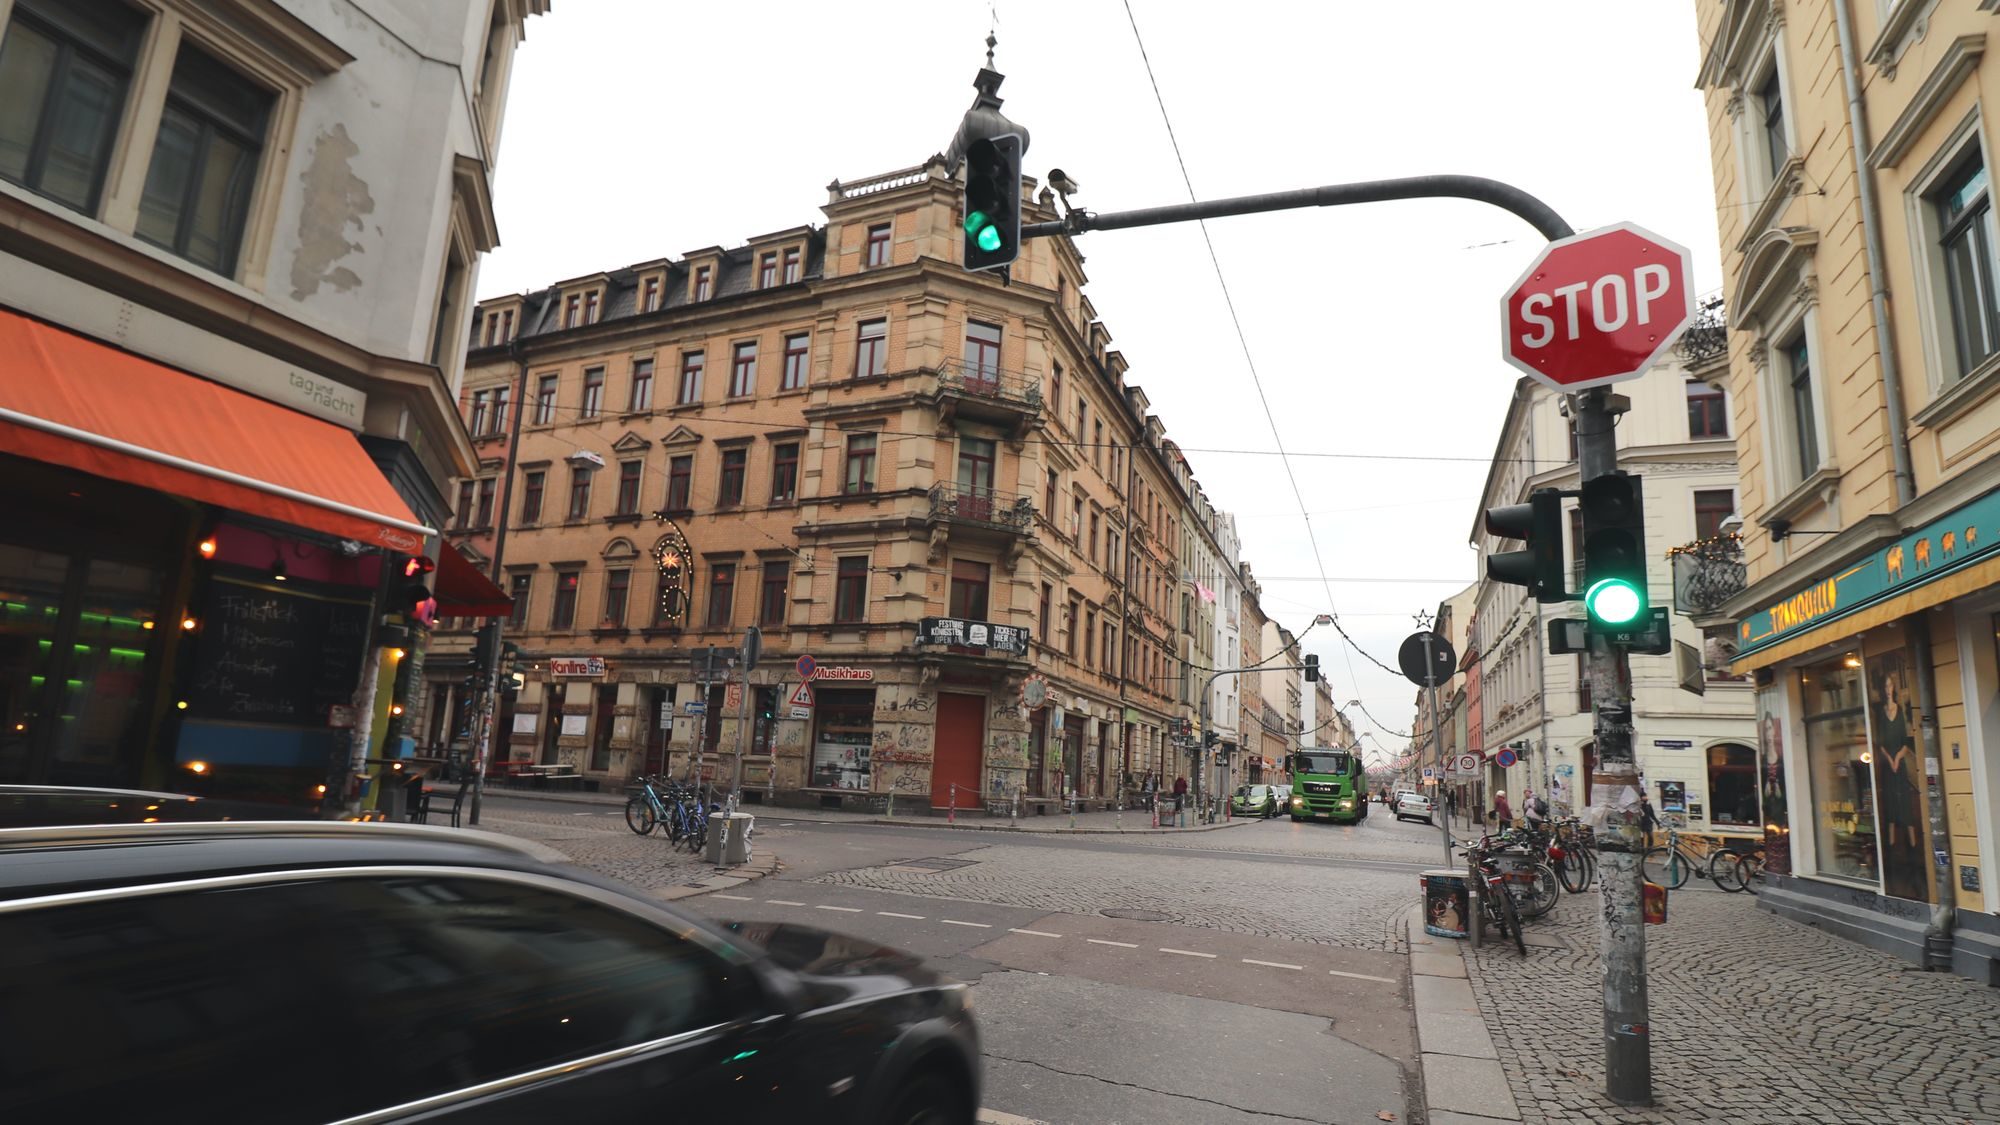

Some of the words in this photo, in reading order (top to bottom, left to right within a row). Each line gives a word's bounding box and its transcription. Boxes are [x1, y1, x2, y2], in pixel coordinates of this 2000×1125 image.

[1520, 263, 1670, 349] STOP
[289, 372, 314, 395] tag
[315, 384, 334, 396] und
[313, 391, 356, 417] nacht
[1769, 577, 1837, 634] TRANQUILLO
[995, 626, 1018, 636] TICKETS
[935, 636, 952, 644] OPEN
[994, 634, 1009, 642] HIER
[994, 642, 1014, 651] LADEN
[812, 667, 872, 680] Musikhaus
[1463, 759, 1473, 767] 30
